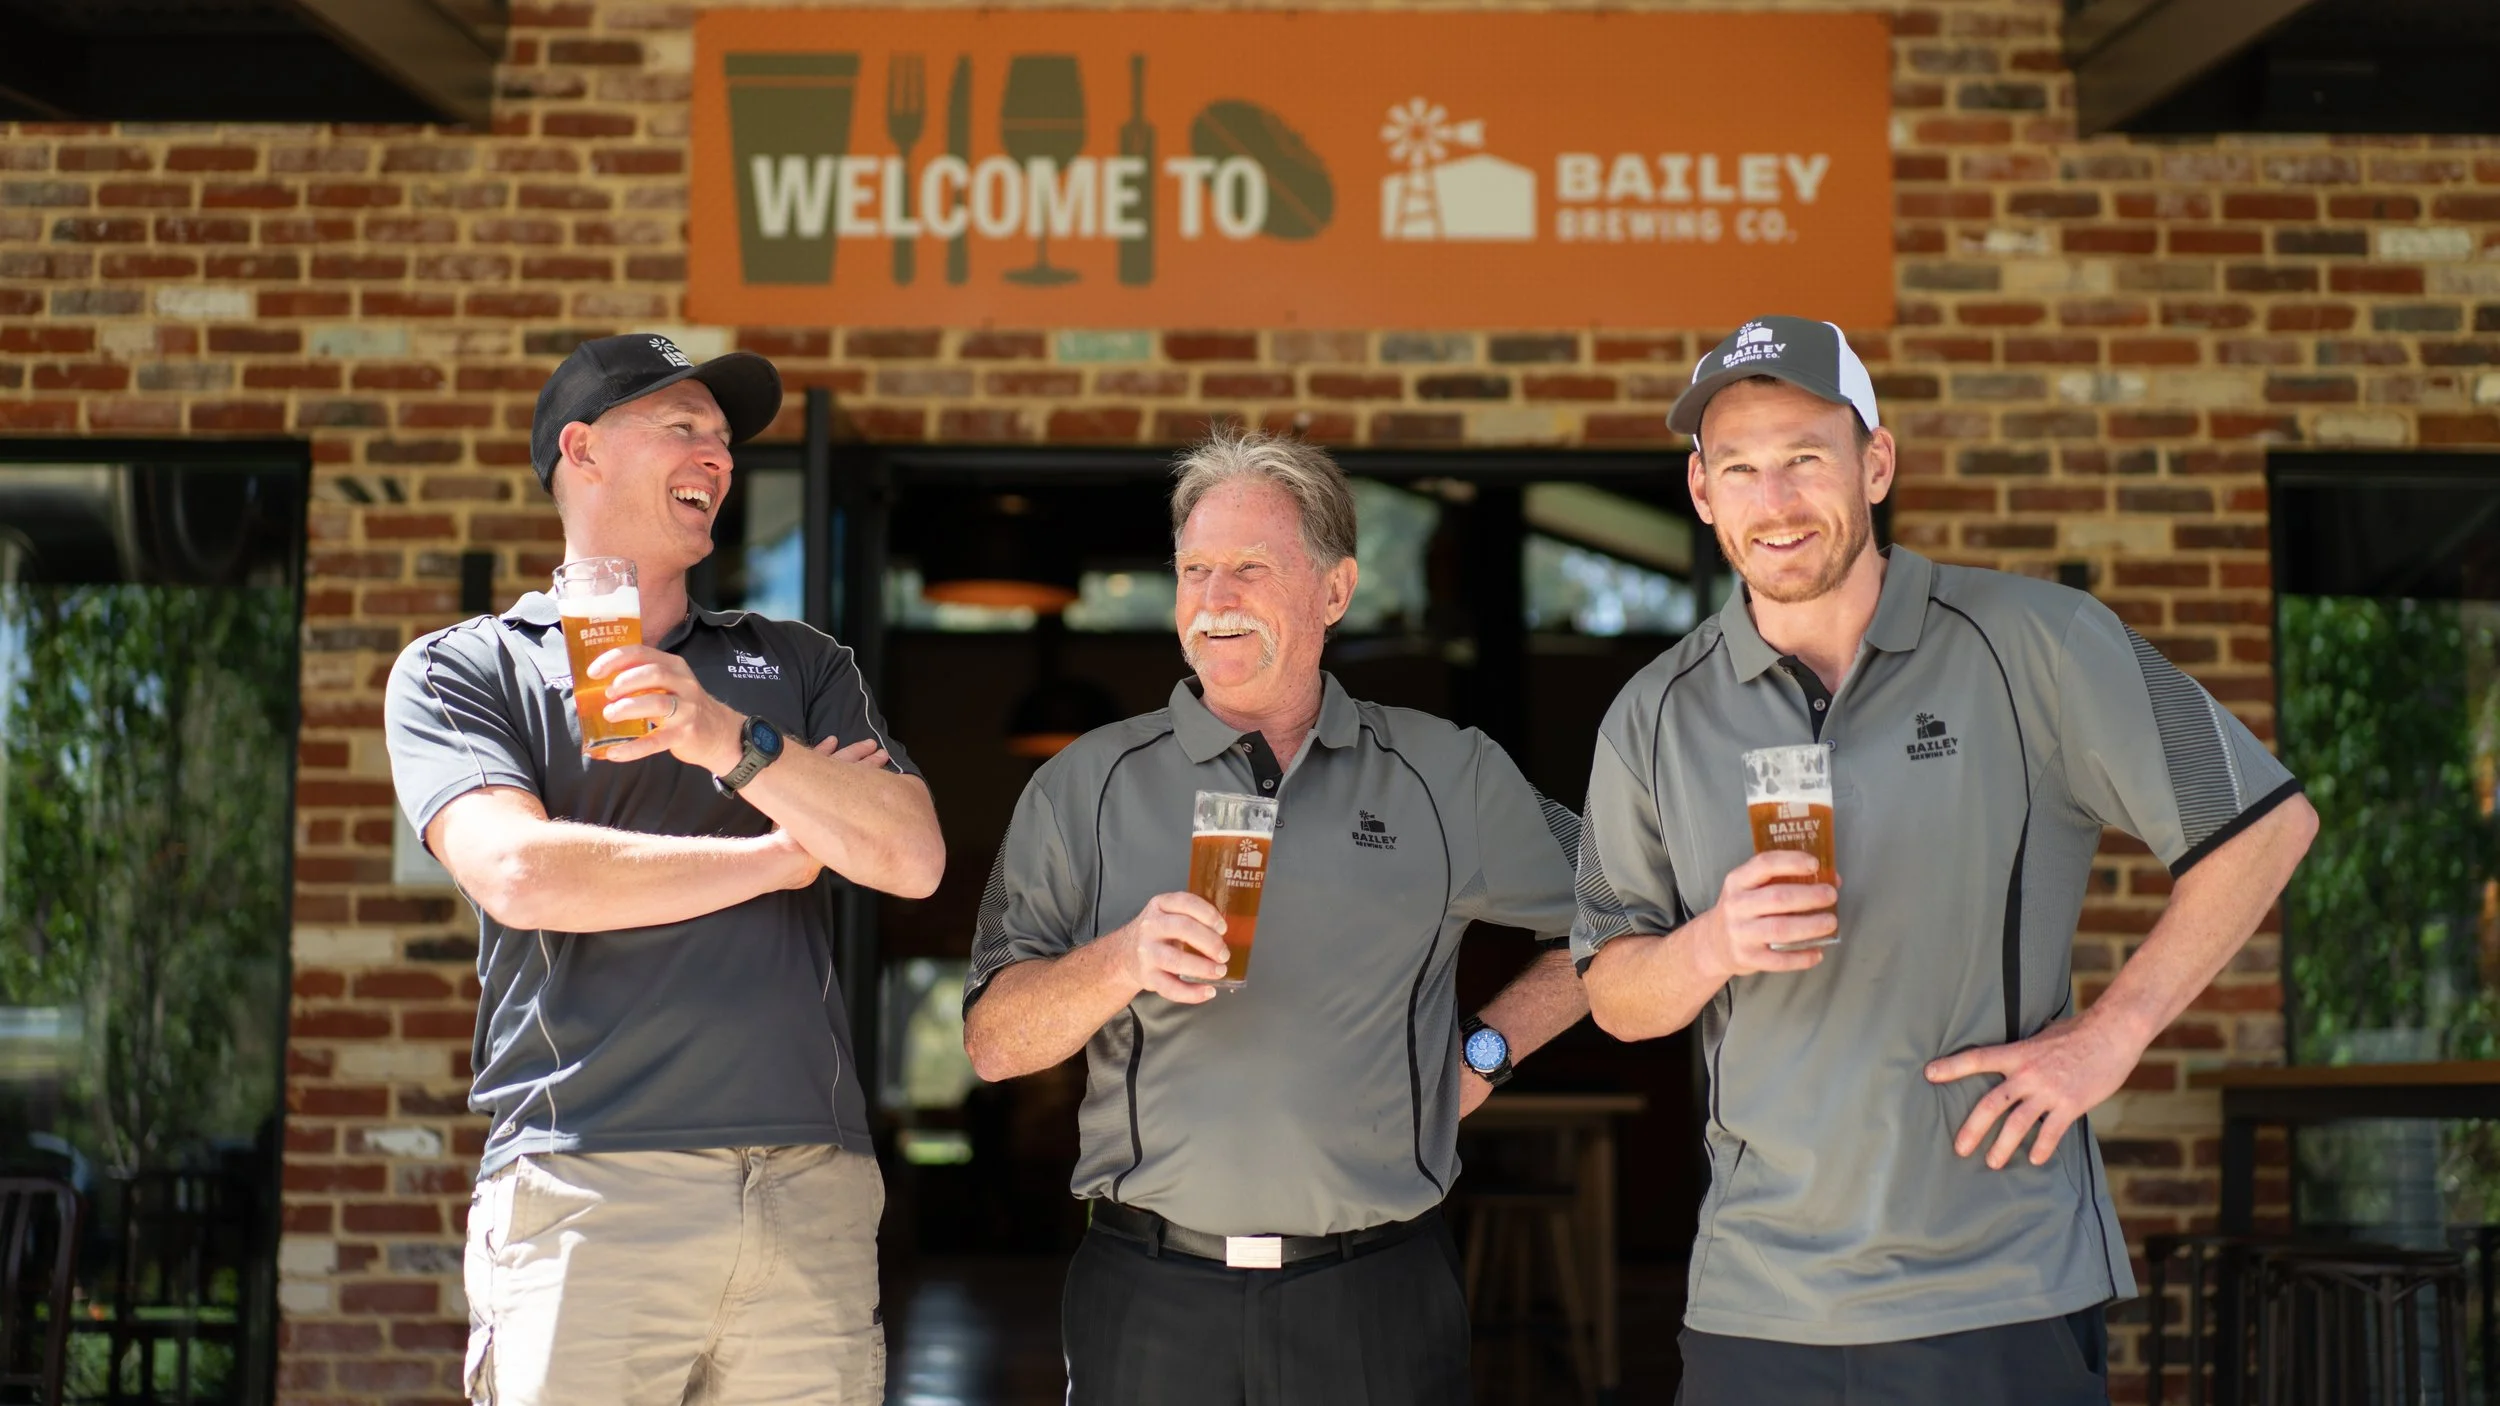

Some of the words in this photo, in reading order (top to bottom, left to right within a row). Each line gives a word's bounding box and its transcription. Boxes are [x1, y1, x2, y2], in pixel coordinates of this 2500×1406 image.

[1556, 153, 1830, 203] BAILEY
[750, 154, 1147, 240] WELCOME
[1164, 154, 1269, 240] TO
[1556, 208, 1723, 242] BREWING
[1735, 208, 1797, 243] CO.
[1723, 343, 1787, 365] BAILEY
[1725, 353, 1762, 369] BREWING
[580, 625, 629, 640] BAILEY
[584, 636, 614, 647] BREWING
[727, 665, 780, 675] BAILEY
[1906, 737, 1958, 754] BAILEY
[1910, 750, 1943, 761] BREWING
[1769, 818, 1820, 835] BAILEY
[1352, 831, 1397, 844] BAILEY
[1773, 831, 1806, 843] BREWING
[1356, 841, 1382, 849] BREWING
